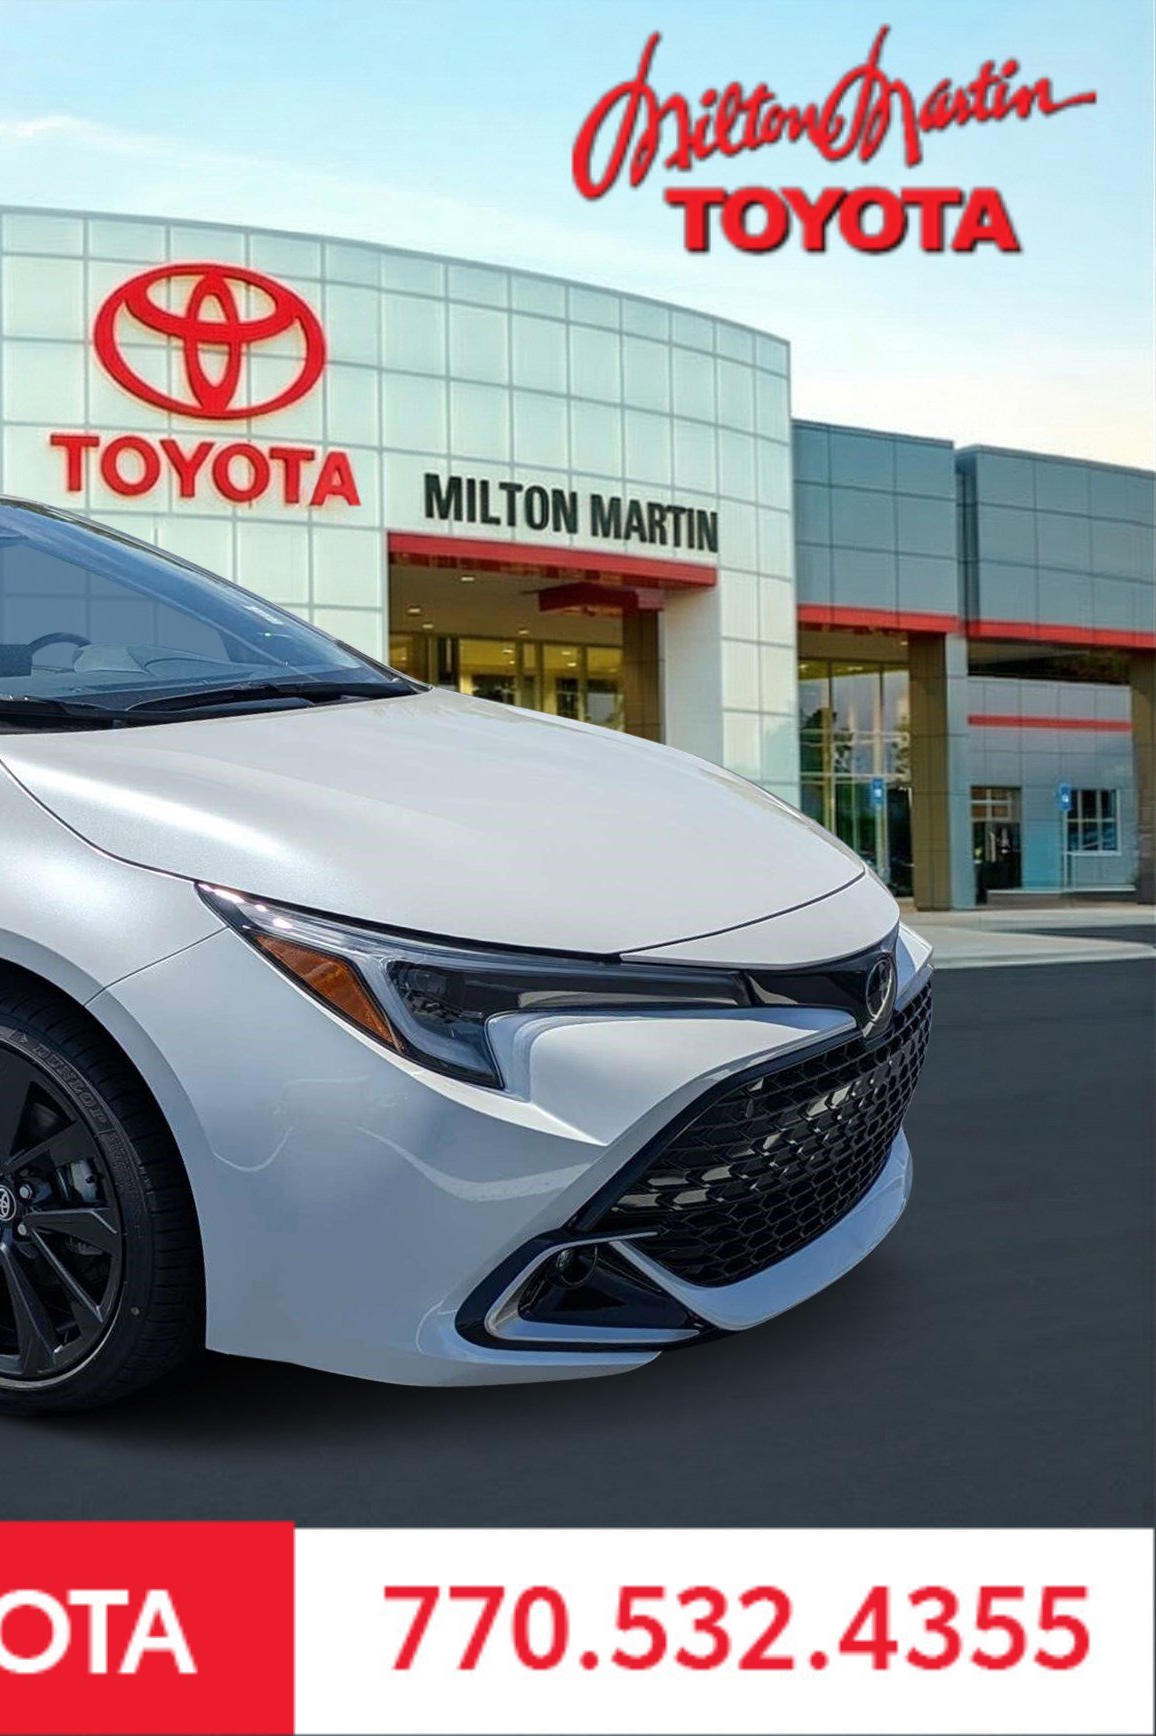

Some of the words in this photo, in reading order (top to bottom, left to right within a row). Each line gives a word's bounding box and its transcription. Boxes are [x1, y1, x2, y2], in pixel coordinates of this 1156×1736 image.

[50, 432, 361, 507] TOYOTA
[424, 473, 578, 534] MILTON
[590, 494, 719, 553] MARTIN
[32, 1042, 109, 1126] DUNLOP
